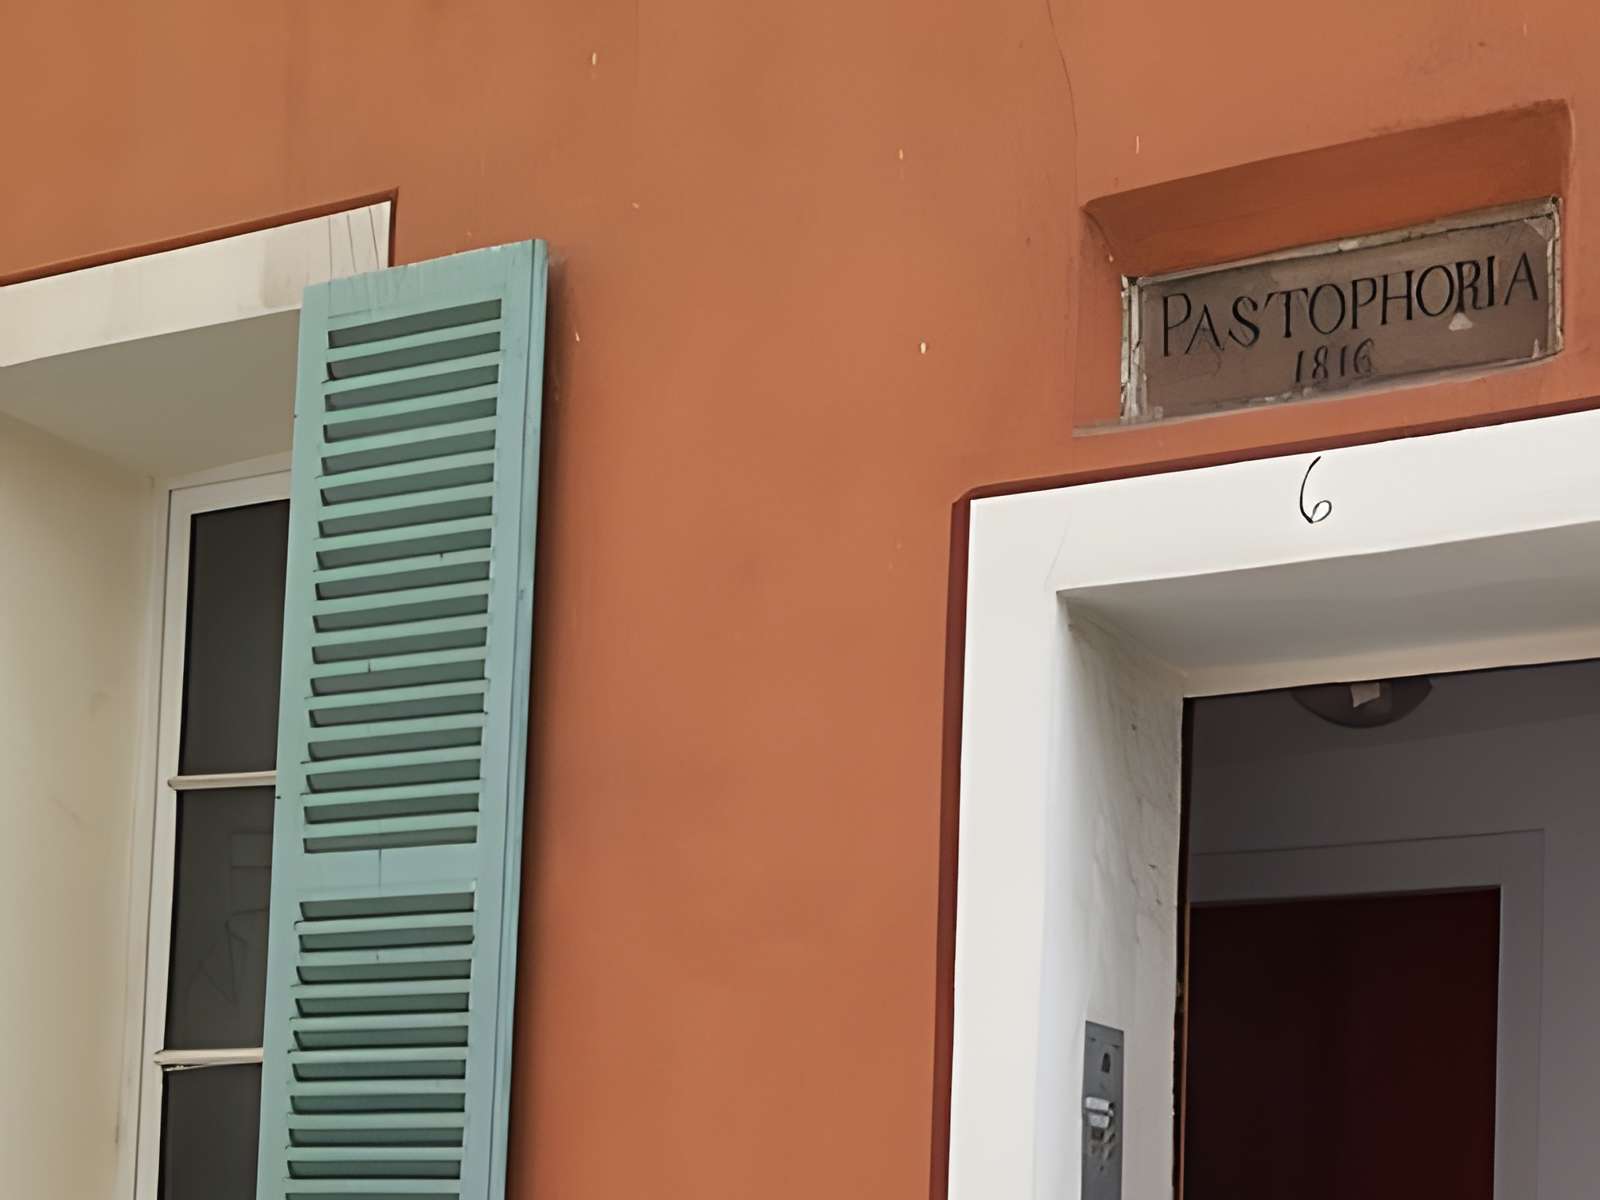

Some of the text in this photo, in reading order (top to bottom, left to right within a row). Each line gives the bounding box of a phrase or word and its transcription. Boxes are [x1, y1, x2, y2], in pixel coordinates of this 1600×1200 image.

[1160, 252, 1540, 357] PASTOPHORIA
[1294, 337, 1375, 383] 1816
[1299, 455, 1333, 523] 6
